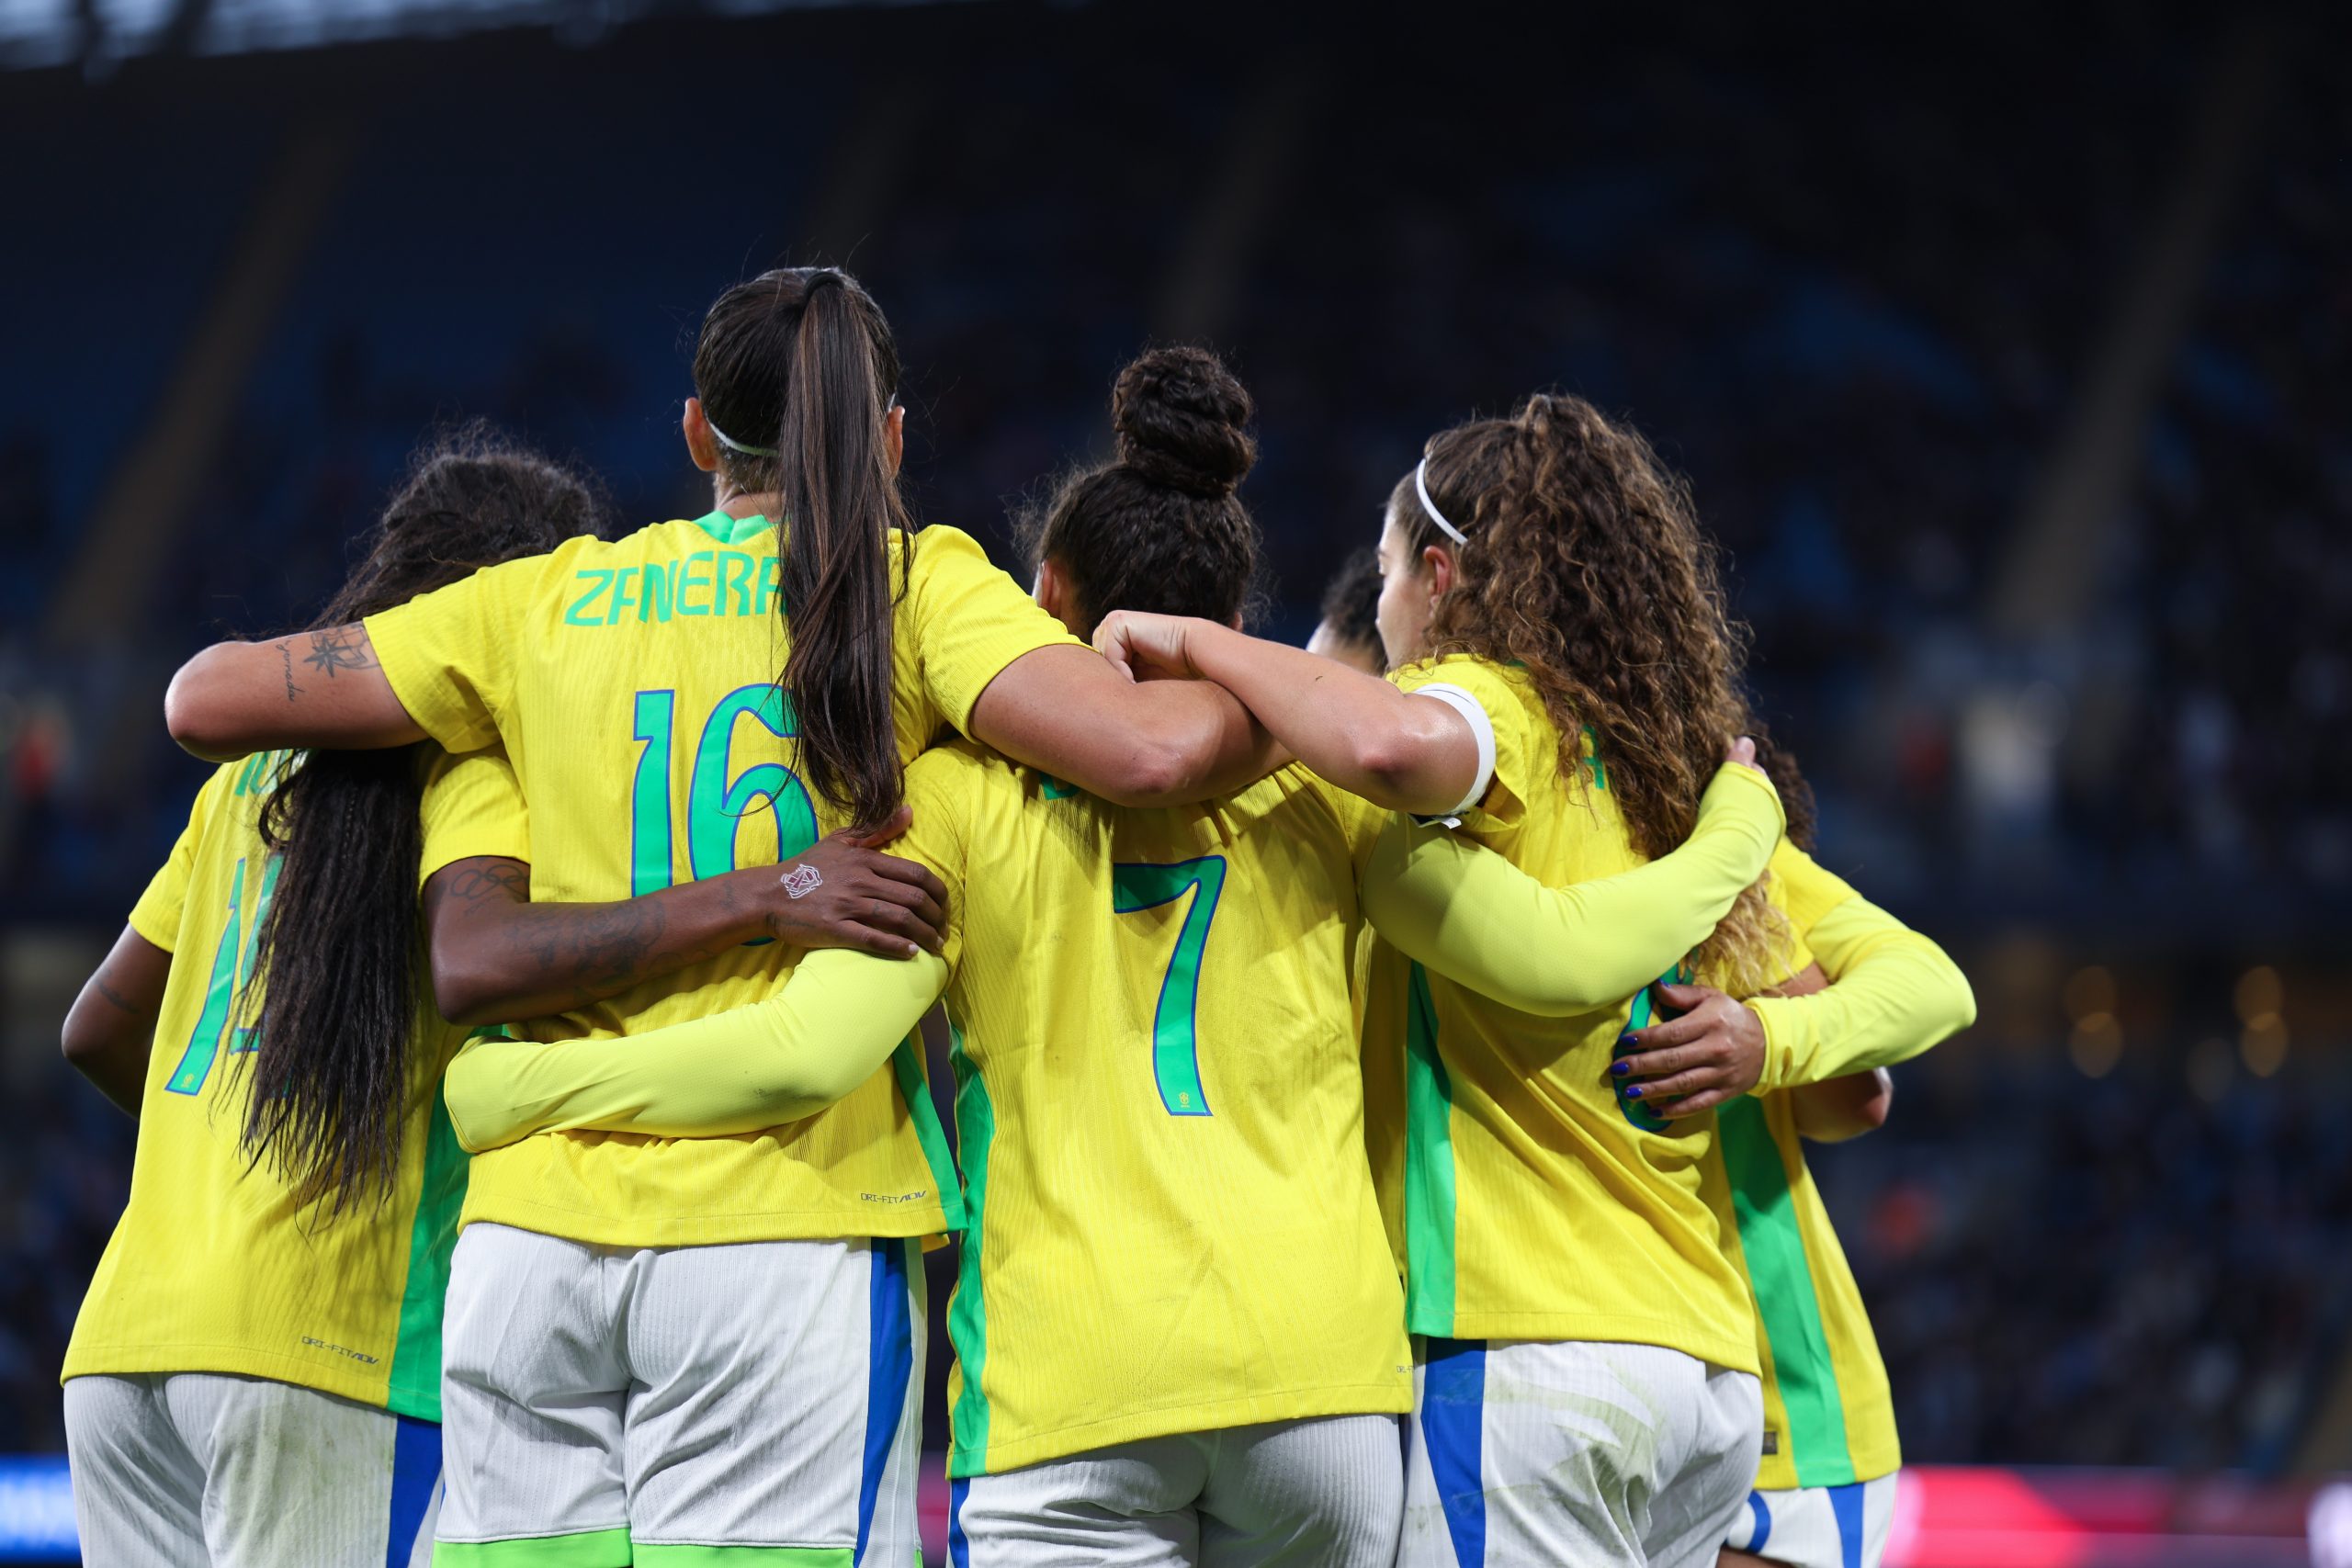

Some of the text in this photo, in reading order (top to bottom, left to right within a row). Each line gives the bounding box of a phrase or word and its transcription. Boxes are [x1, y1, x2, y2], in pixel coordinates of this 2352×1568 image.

[564, 550, 788, 626] ZANERA
[631, 682, 820, 946] 16
[1113, 855, 1227, 1117] 7
